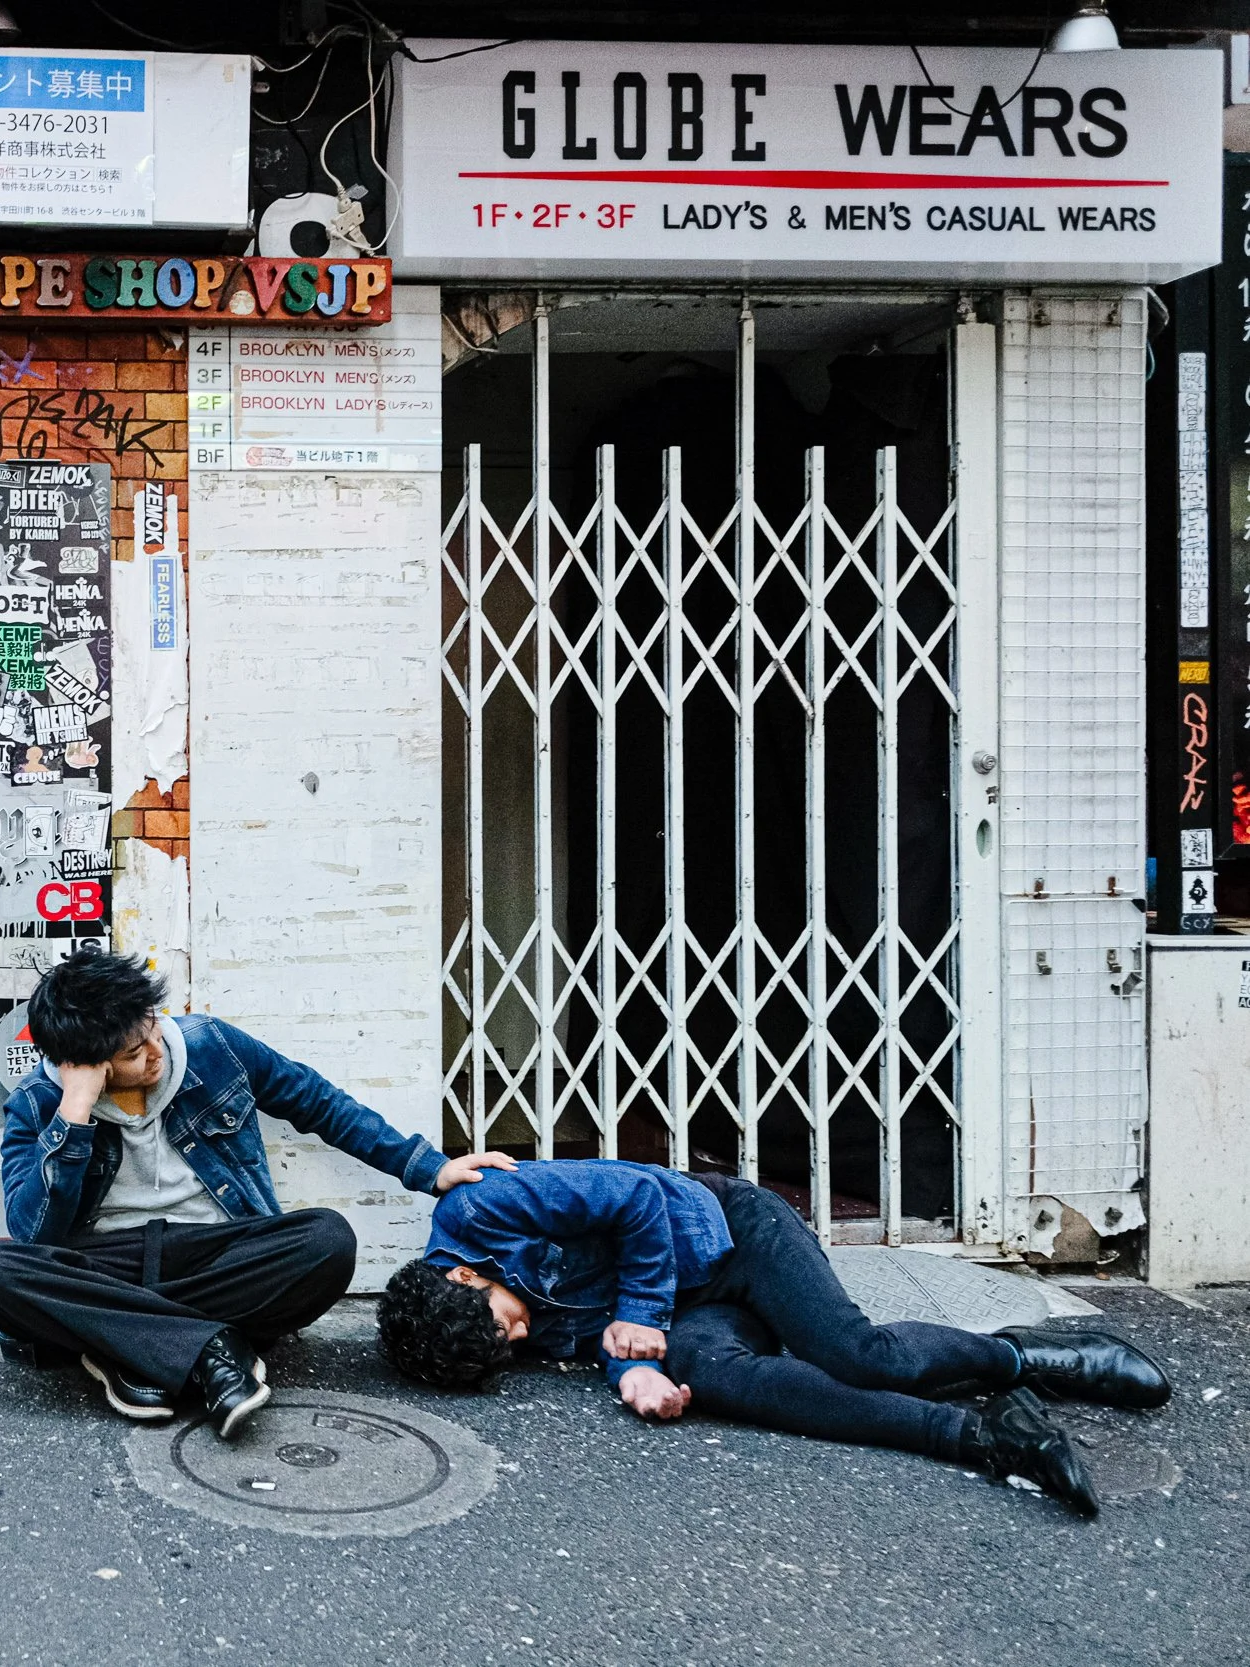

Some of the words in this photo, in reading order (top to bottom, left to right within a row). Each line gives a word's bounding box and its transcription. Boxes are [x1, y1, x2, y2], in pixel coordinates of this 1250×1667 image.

[502, 70, 766, 162] GLOBE
[834, 84, 1128, 159] WEARS
[99, 169, 121, 181] 検索
[663, 201, 768, 230] LADY'S
[788, 206, 807, 229] &
[825, 201, 911, 231] MEN'S
[927, 206, 1045, 232] CASUAL
[1058, 206, 1156, 232] WEARS
[83, 257, 225, 309] SHOP
[245, 263, 388, 317] VSJP
[196, 342, 222, 356] 4F
[240, 343, 325, 356] BROOKLYN
[197, 369, 222, 384] 3F
[240, 370, 325, 384] BROOKLYN
[197, 397, 222, 410] 2F
[241, 396, 325, 410] BROOKLYN
[29, 465, 92, 484] ZEMOK
[10, 489, 60, 511] BITER
[10, 516, 60, 528] TORTURED
[145, 482, 163, 544] ZEMOK
[10, 529, 22, 541] BY
[25, 529, 60, 541] KARMA
[156, 563, 171, 645] FEARLESS
[47, 664, 100, 713] ZEMOK
[34, 704, 86, 730] MEMS
